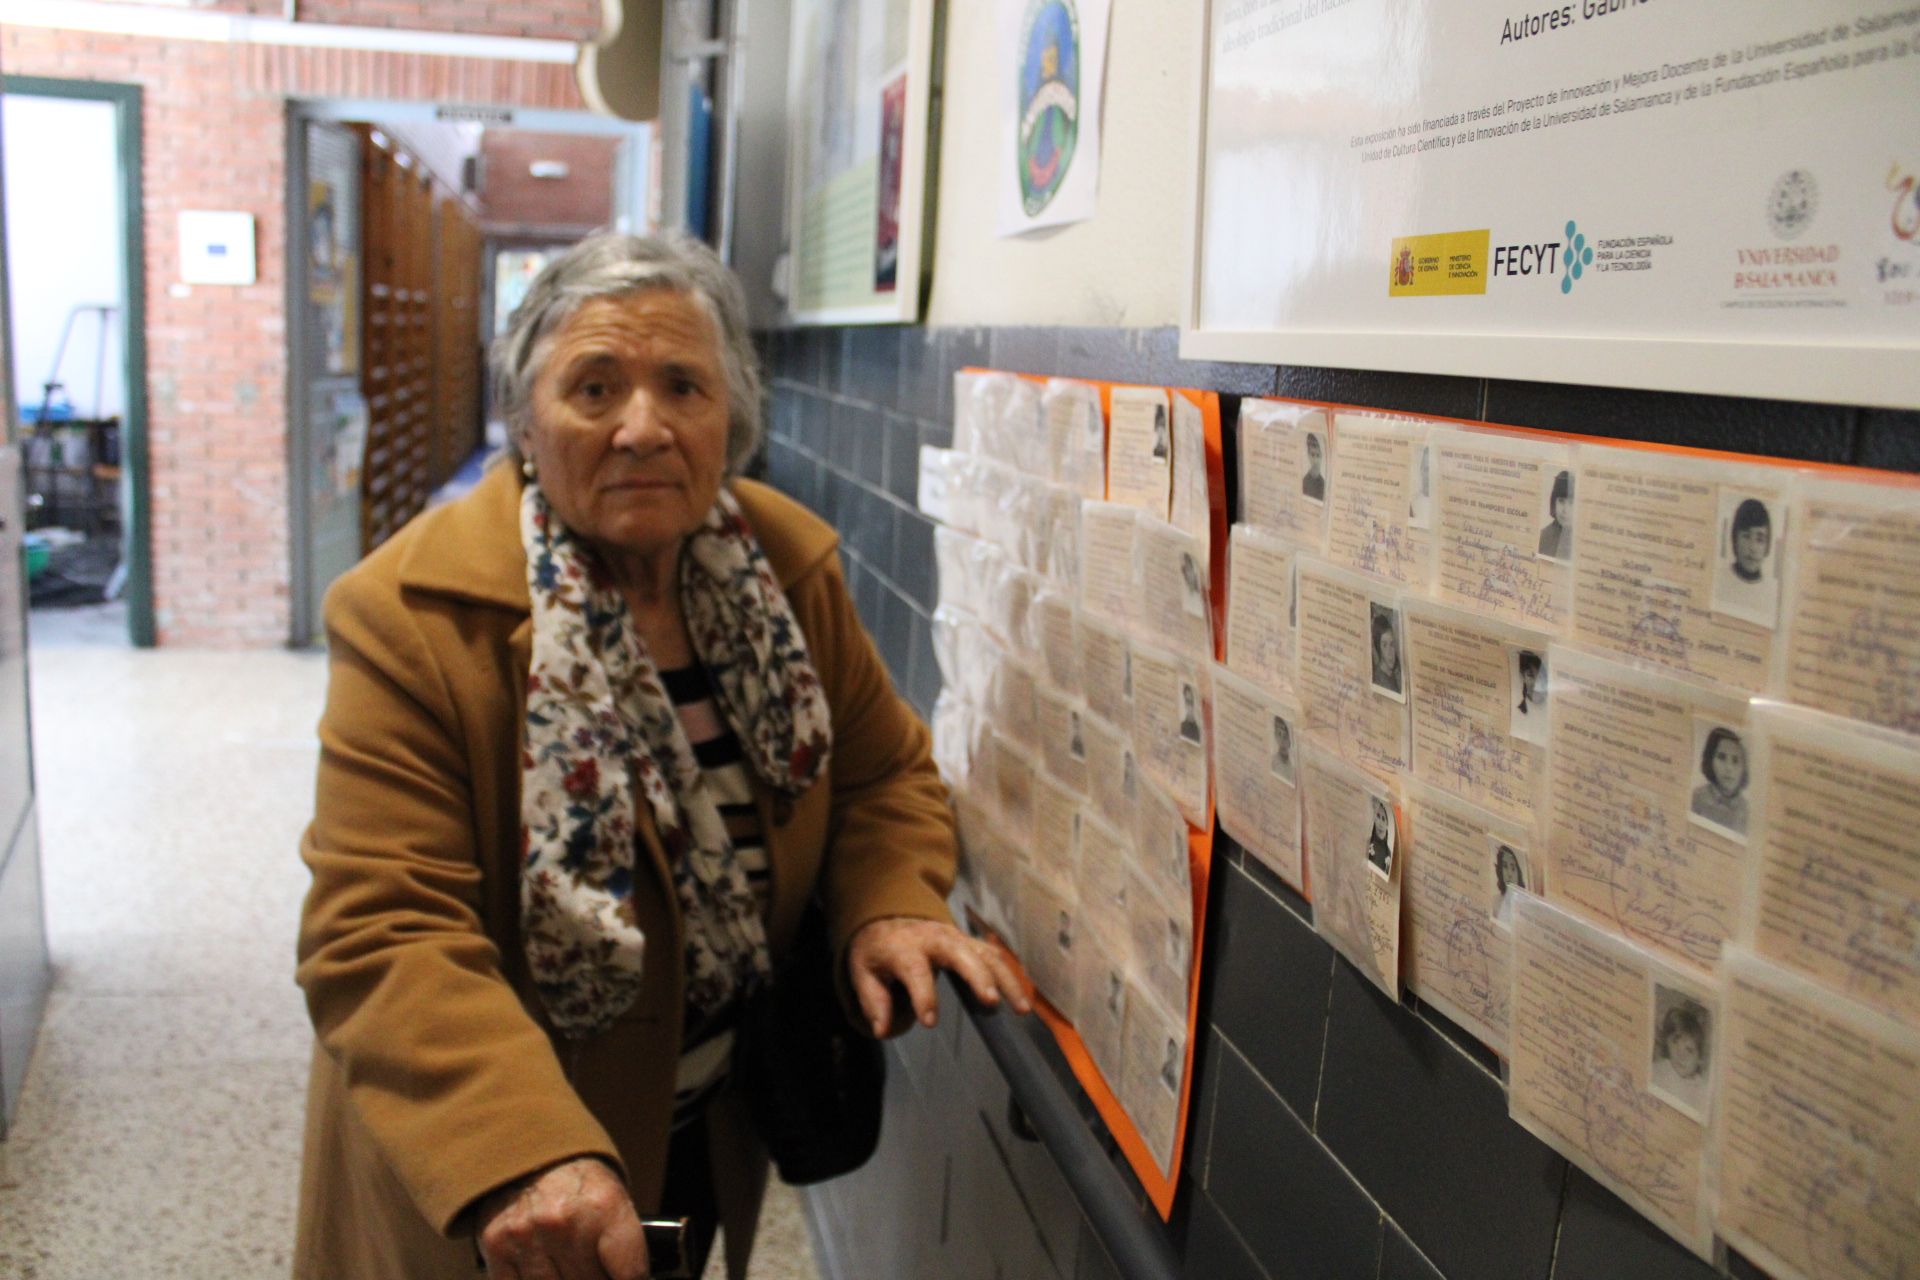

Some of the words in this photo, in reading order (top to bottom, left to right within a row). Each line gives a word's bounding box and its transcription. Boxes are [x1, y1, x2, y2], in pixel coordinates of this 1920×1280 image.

[1500, 4, 1577, 46] Autores:
[1361, 148, 1383, 163] Unidad
[1383, 147, 1392, 159] de
[1392, 142, 1417, 157] Cultura
[1417, 135, 1450, 153] Científica
[1450, 136, 1457, 149] y
[1457, 131, 1466, 145] de
[1467, 129, 1475, 142] la
[1476, 119, 1519, 141] Innovación
[1520, 117, 1531, 132] de
[1532, 115, 1541, 130] la
[1543, 104, 1598, 128] Universidad
[1598, 101, 1611, 117] de
[1613, 91, 1673, 114] Salamanca
[1673, 90, 1682, 106] y
[1684, 83, 1698, 101] de
[1700, 80, 1712, 97] la
[1714, 68, 1780, 93] Fundación
[1364, 128, 1397, 147] exposición
[1397, 125, 1406, 138] ha
[1407, 122, 1421, 136] sido
[1422, 115, 1459, 133] financiada
[1460, 114, 1466, 125] a
[1467, 106, 1491, 123] través
[1492, 102, 1505, 118] del
[1507, 95, 1545, 115] Proyecto
[1546, 90, 1559, 106] de
[1613, 79, 1621, 95] y
[1622, 70, 1658, 89] Mejora
[1661, 58, 1709, 80] Docente
[1712, 52, 1728, 69] de
[1730, 49, 1744, 65] la
[1494, 243, 1560, 276] FECYT
